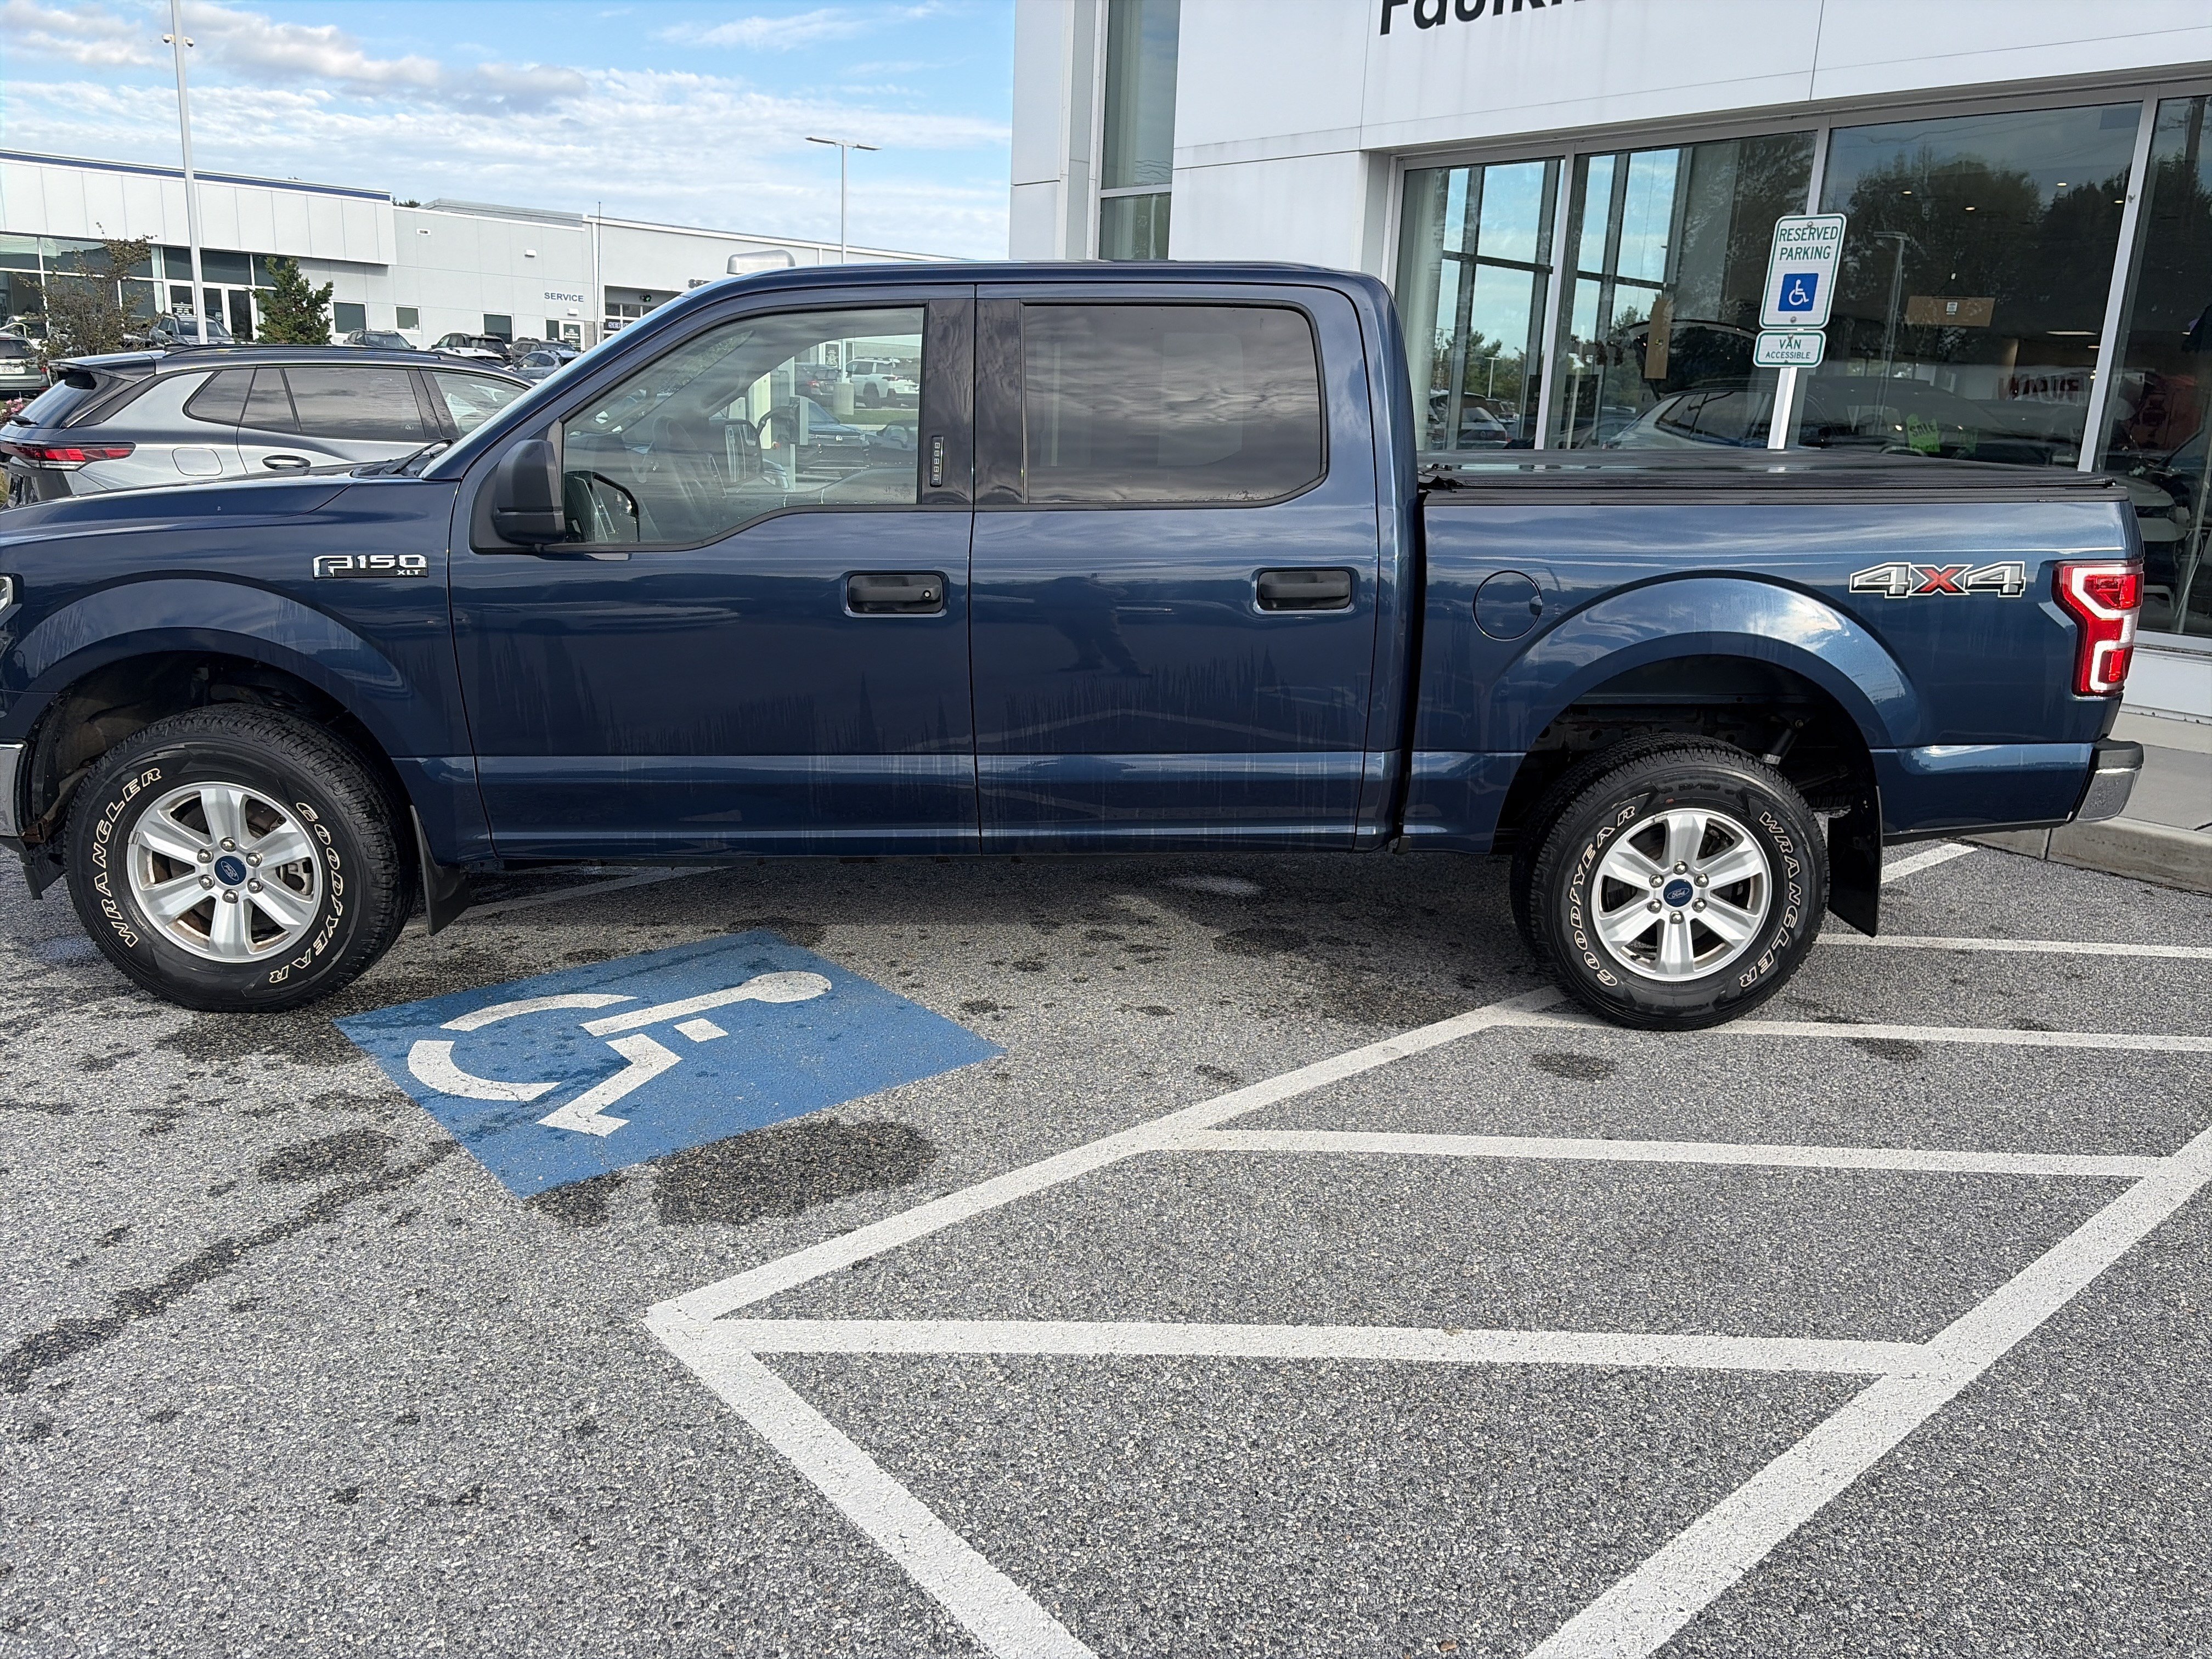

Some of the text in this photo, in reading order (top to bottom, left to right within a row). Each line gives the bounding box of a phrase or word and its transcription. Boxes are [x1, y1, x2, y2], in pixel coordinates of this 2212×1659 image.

[1779, 226, 1838, 241] RESERVED
[1780, 245, 1831, 261] PARKING
[544, 292, 584, 302] SERVICE
[1779, 339, 1802, 349] VAN
[92, 768, 162, 948] WRANGLER
[269, 802, 343, 983] GOODYEAR
[1570, 806, 1635, 986] GOODYEAR
[1671, 889, 1686, 899] Ford
[1740, 811, 1802, 987] WRANGLER
